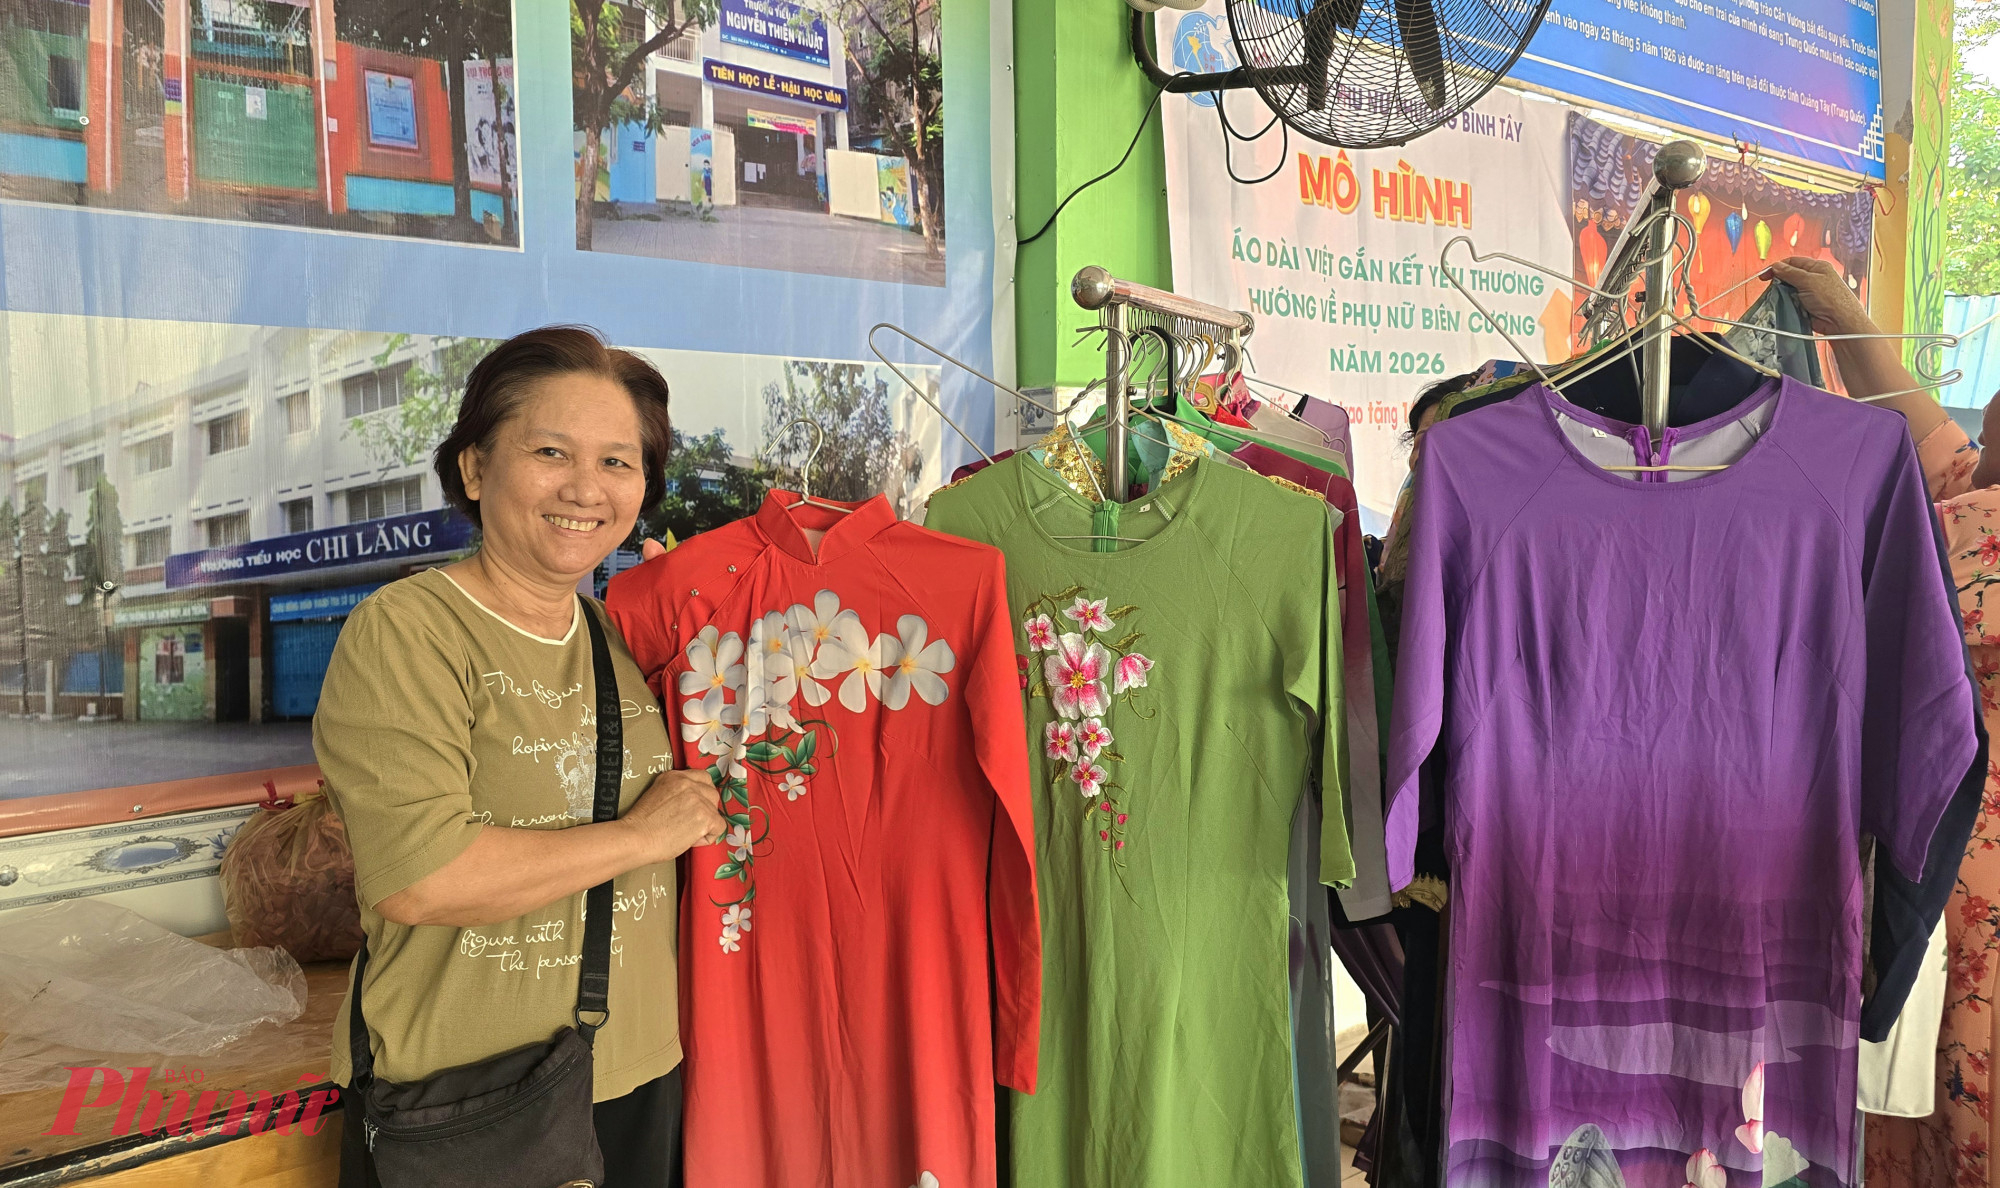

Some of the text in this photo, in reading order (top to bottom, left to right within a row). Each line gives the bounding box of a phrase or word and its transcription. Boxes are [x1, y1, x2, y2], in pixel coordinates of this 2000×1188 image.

[726, 10, 766, 36] NGUYỄN
[768, 21, 795, 46] THIỆN
[1640, 2, 1662, 24] không
[1664, 10, 1687, 30] thành.
[1689, 0, 1702, 12] cho
[1704, 4, 1714, 16] em
[1716, 6, 1727, 22] trai
[1728, 10, 1740, 26] của
[1742, 17, 1758, 33] mình
[1768, 29, 1784, 46] sang
[1784, 32, 1802, 53] Trung
[1804, 40, 1818, 56] Quốc
[1828, 31, 1838, 46] suy
[711, 66, 734, 82] TIÊN
[738, 72, 760, 88] HỌC
[782, 81, 800, 97] HẬU
[804, 86, 822, 102] HỌC
[825, 90, 842, 104] VĂN
[1562, 14, 1578, 31] vào
[1580, 20, 1600, 40] ngày
[1600, 26, 1610, 41] 25
[1612, 30, 1634, 52] tháng
[1636, 38, 1640, 50] 5
[1642, 41, 1658, 57] năm
[1660, 45, 1676, 63] 1926
[1678, 51, 1686, 66] và
[1688, 54, 1704, 73] được
[1706, 62, 1714, 75] an
[1716, 64, 1731, 84] táng
[1732, 68, 1744, 86] trên
[1746, 74, 1758, 90] quả
[1770, 81, 1787, 100] thuộc
[1800, 92, 1818, 112] Quảng
[1820, 99, 1830, 116] Tây
[1830, 104, 1849, 122] (Trung
[1462, 107, 1496, 137] BÌNH
[1500, 114, 1523, 142] TÂY
[1298, 149, 1472, 229] MÔ HÌNH
[1232, 226, 1544, 296] ÁO DÀI VIỆT GẮN KẾT YÊU THƯƠNG
[1248, 285, 1536, 336] HƯỚNG VỀ PHỤ NỮ BIÊN CƯƠNG
[1330, 344, 1445, 374] NĂM 2026
[1368, 401, 1398, 430] tặng
[276, 549, 302, 564] HỌC
[306, 534, 349, 564] CHI
[356, 521, 432, 556] LĂNG
[460, 920, 564, 958] figure with
